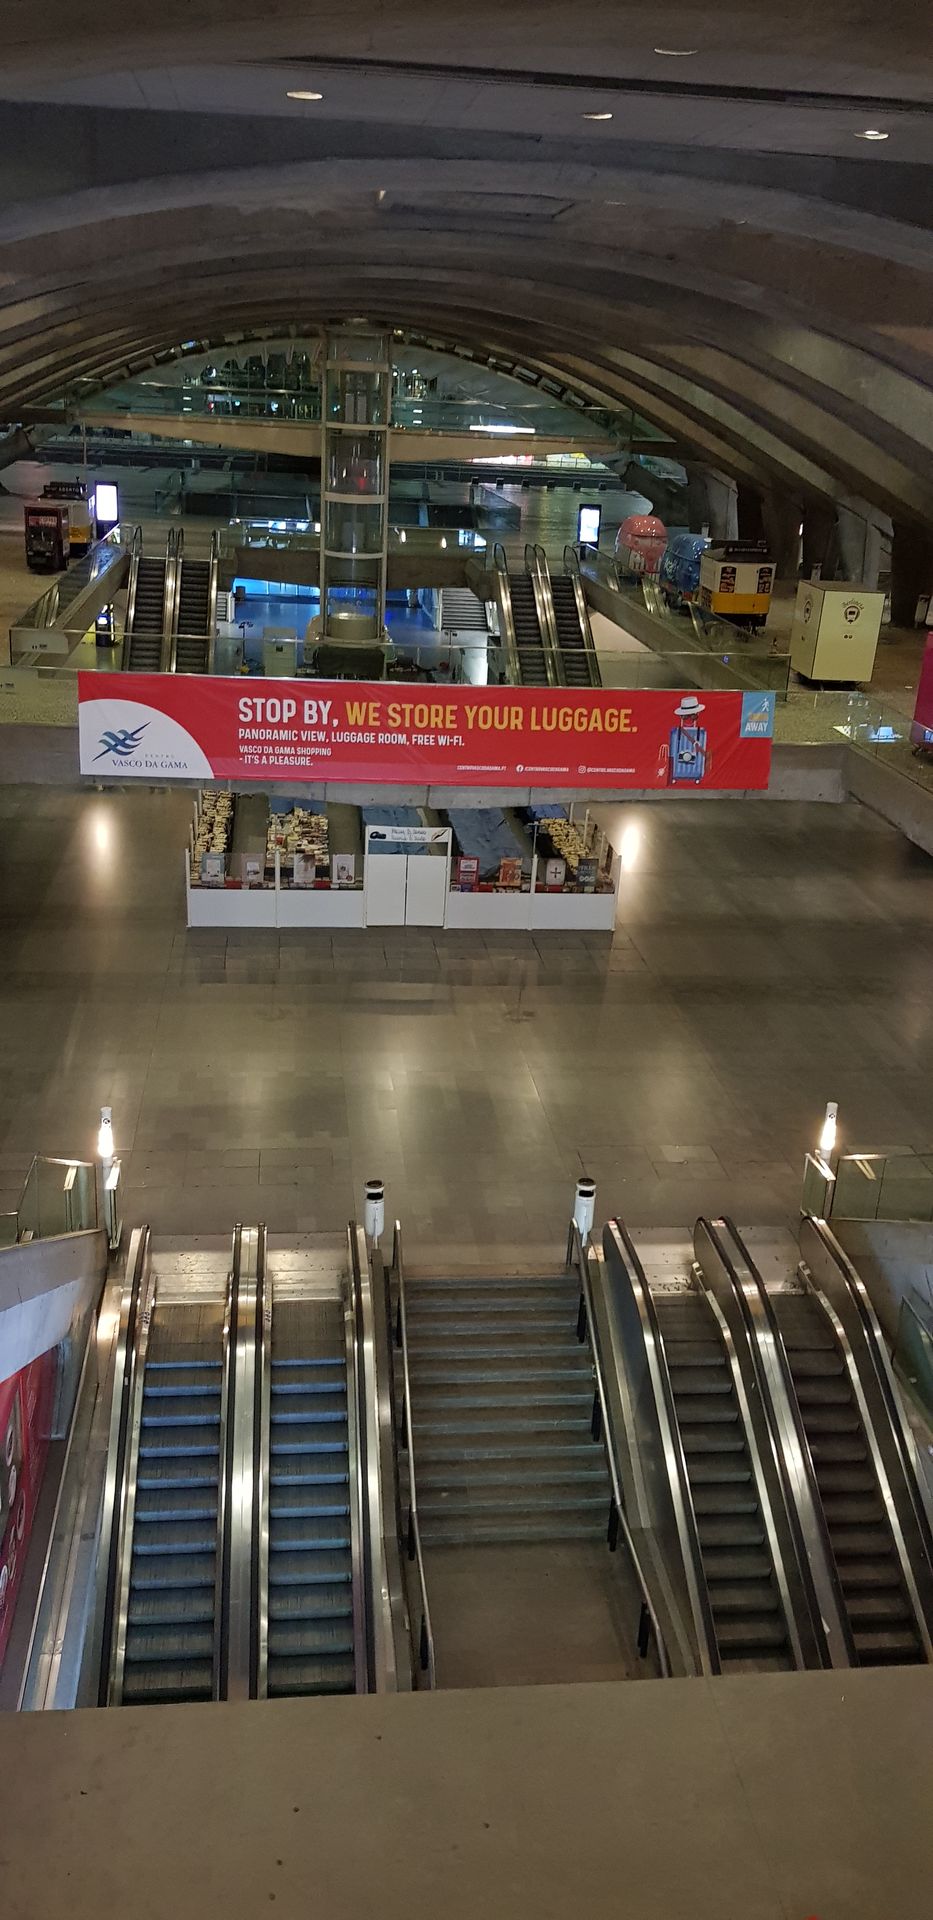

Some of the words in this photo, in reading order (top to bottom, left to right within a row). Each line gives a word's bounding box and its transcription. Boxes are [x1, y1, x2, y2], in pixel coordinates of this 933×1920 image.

[239, 697, 297, 723] STOP
[303, 700, 339, 727] BY,
[345, 701, 381, 727] WE
[387, 703, 458, 729] STORE
[464, 705, 524, 731] YOUR
[530, 706, 638, 733] LUGGAGE.
[745, 721, 768, 732] AWAY
[239, 728, 298, 741] PANORAMIC
[300, 730, 329, 743] VIEW,
[331, 731, 376, 744] LUGGAGE
[378, 733, 410, 746] ROOM,
[412, 734, 435, 746] FREE
[437, 735, 465, 747] WI-FI.
[239, 745, 261, 753] VASCO
[263, 746, 274, 754] DA
[274, 746, 296, 755] GAMA
[296, 747, 332, 756] SHOPPING
[112, 759, 142, 768] VASCO
[145, 760, 158, 768] DA
[160, 760, 188, 769] GAMA
[244, 755, 260, 765] IT'S
[261, 756, 268, 764] A
[269, 756, 314, 766] PLEASURE.
